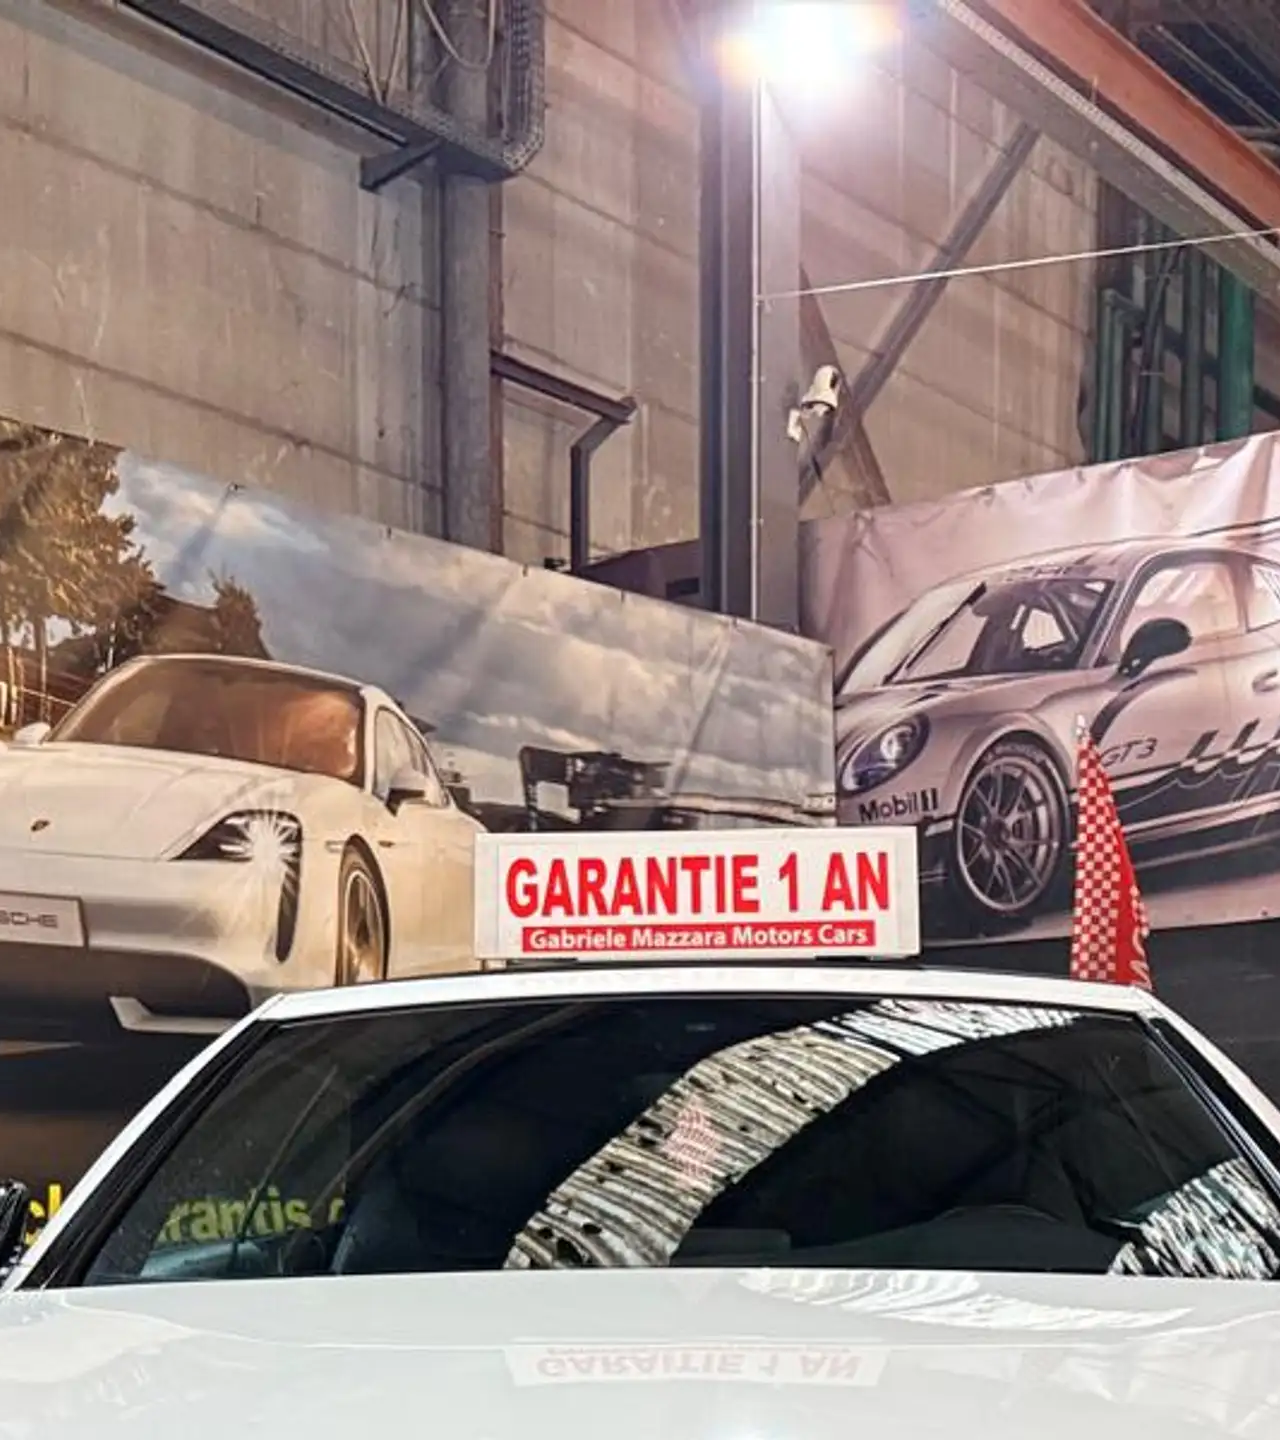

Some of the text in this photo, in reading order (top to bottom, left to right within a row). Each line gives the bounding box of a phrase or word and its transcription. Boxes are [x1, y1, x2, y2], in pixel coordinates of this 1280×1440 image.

[1100, 736, 1158, 768] GT3
[506, 851, 889, 918] GARANTIE 1 AN
[529, 923, 867, 950] Gabriele Mazzara Motors Cars
